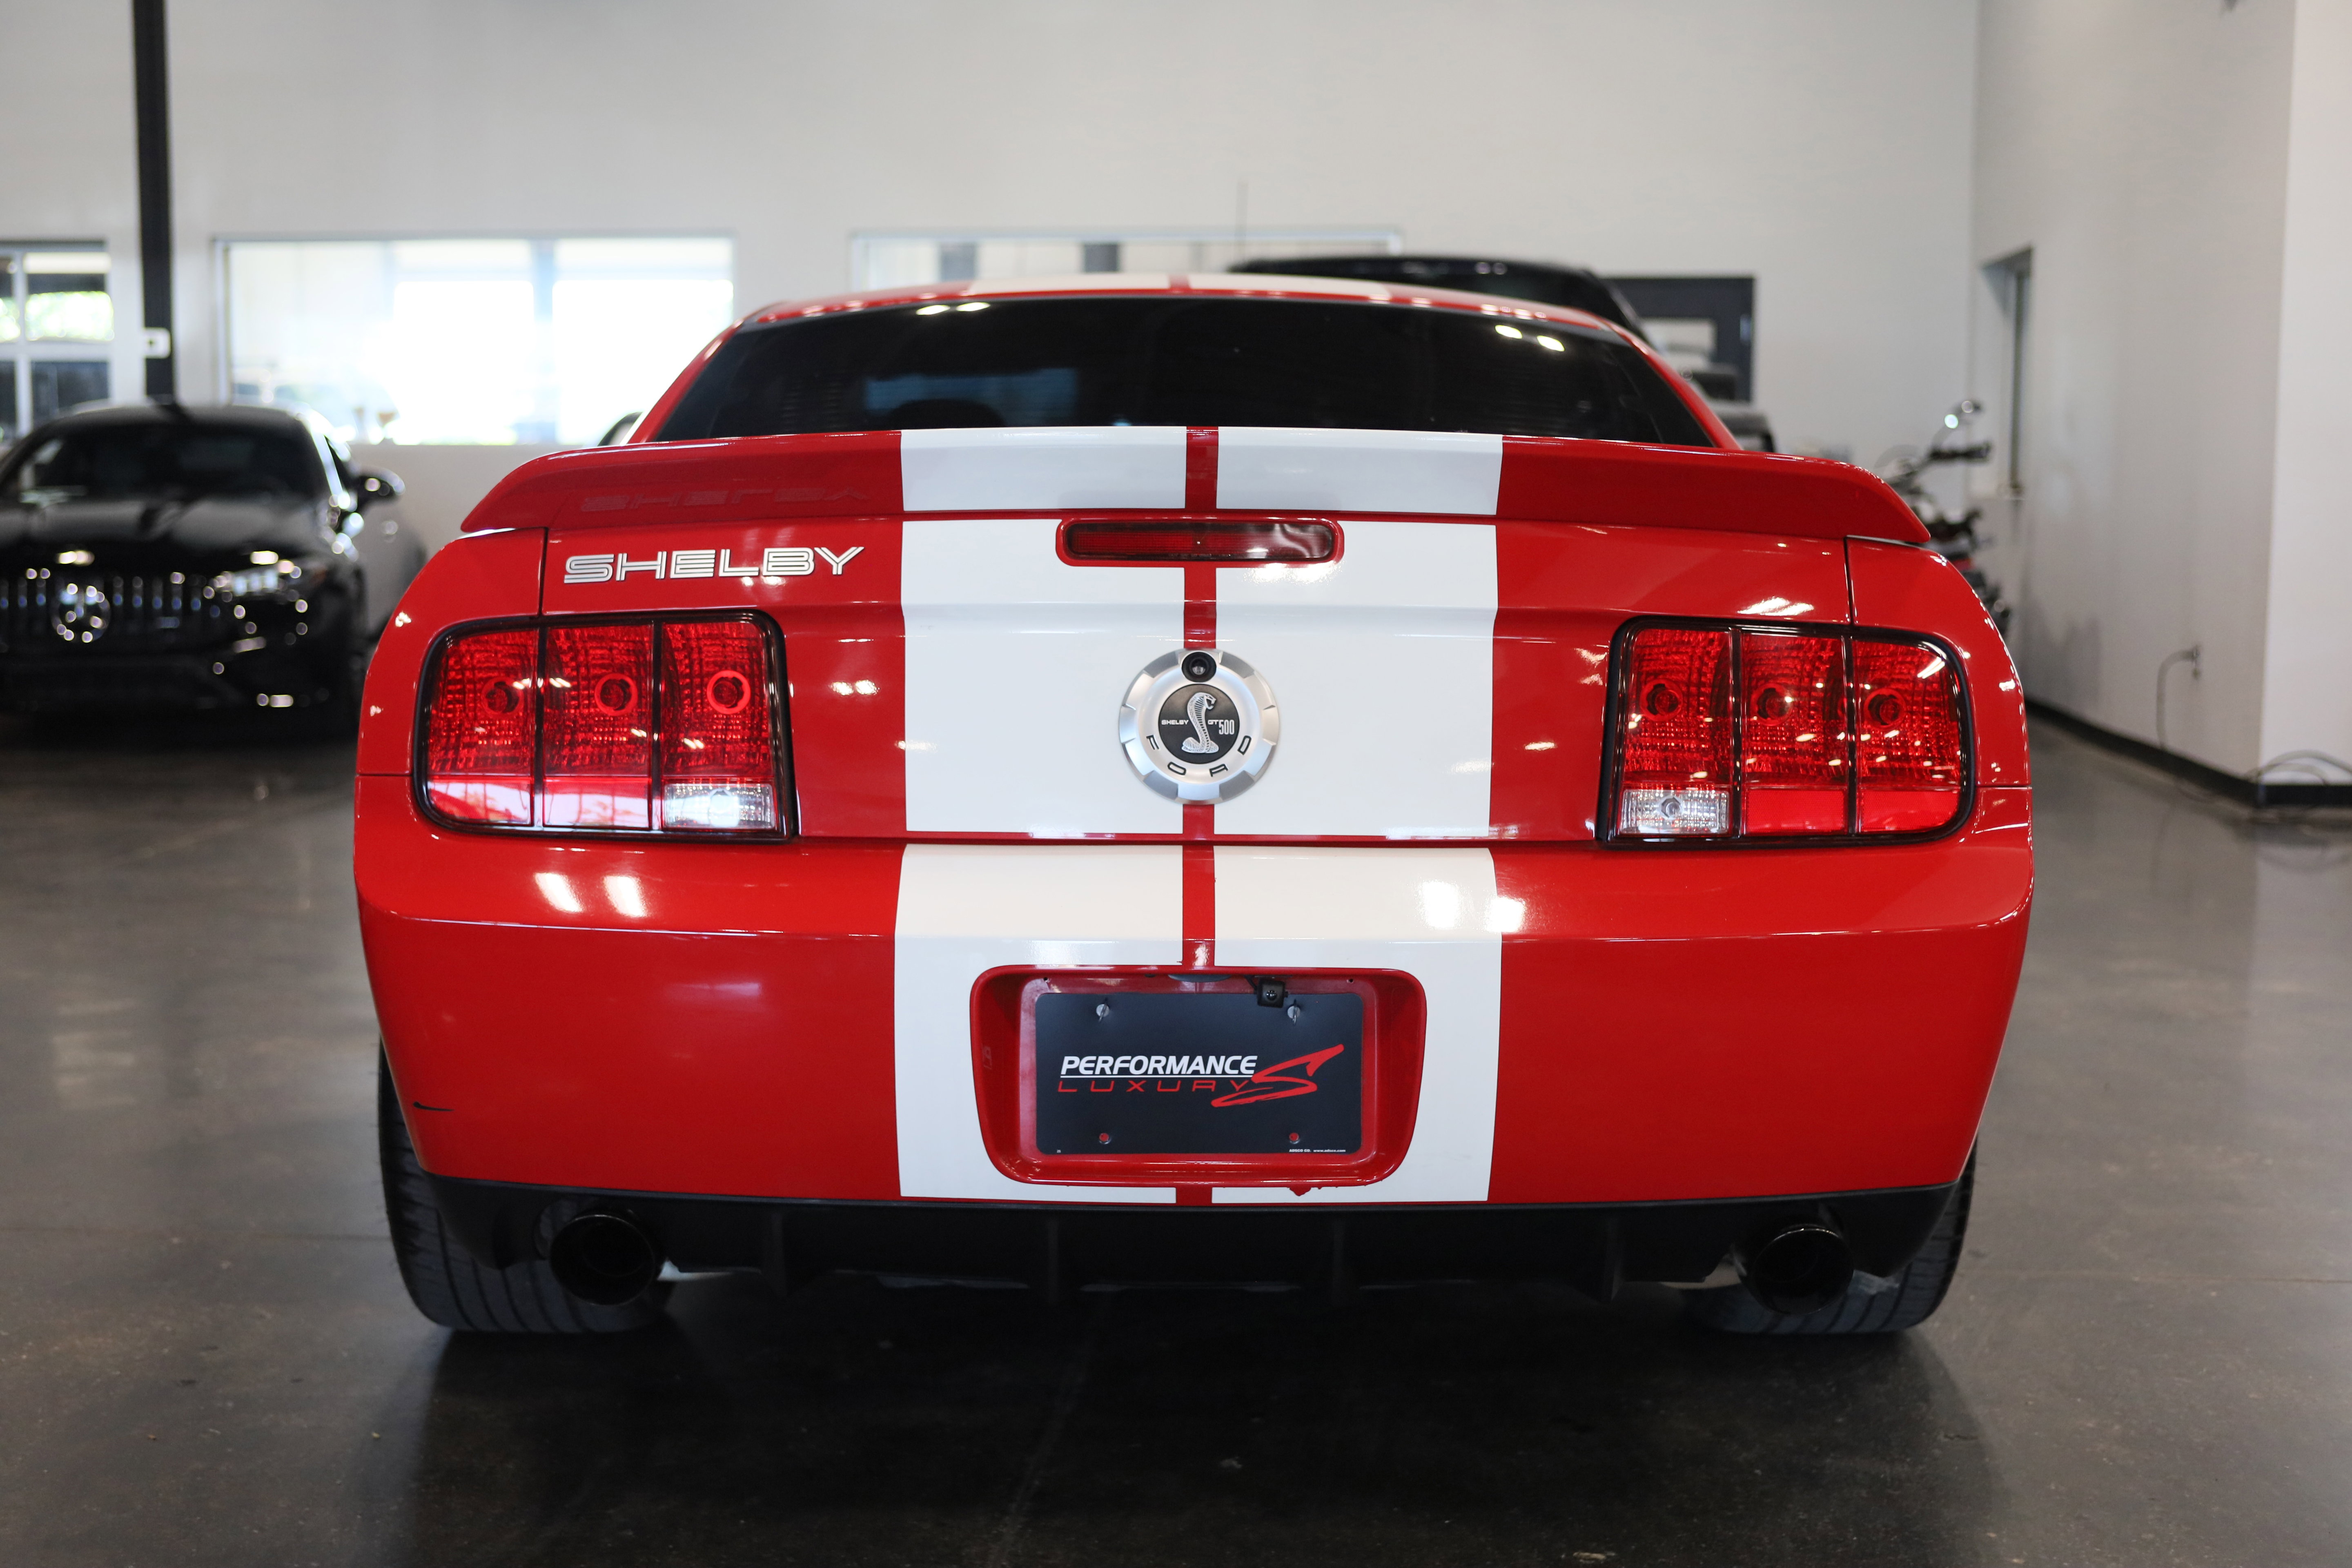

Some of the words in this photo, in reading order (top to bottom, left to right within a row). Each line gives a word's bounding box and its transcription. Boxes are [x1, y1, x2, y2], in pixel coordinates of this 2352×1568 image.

[564, 546, 865, 584] SHELBY
[1146, 735, 1252, 777] FORD
[1061, 1055, 1258, 1075] PERFORMANCE
[1058, 1080, 1249, 1092] LUXURY
